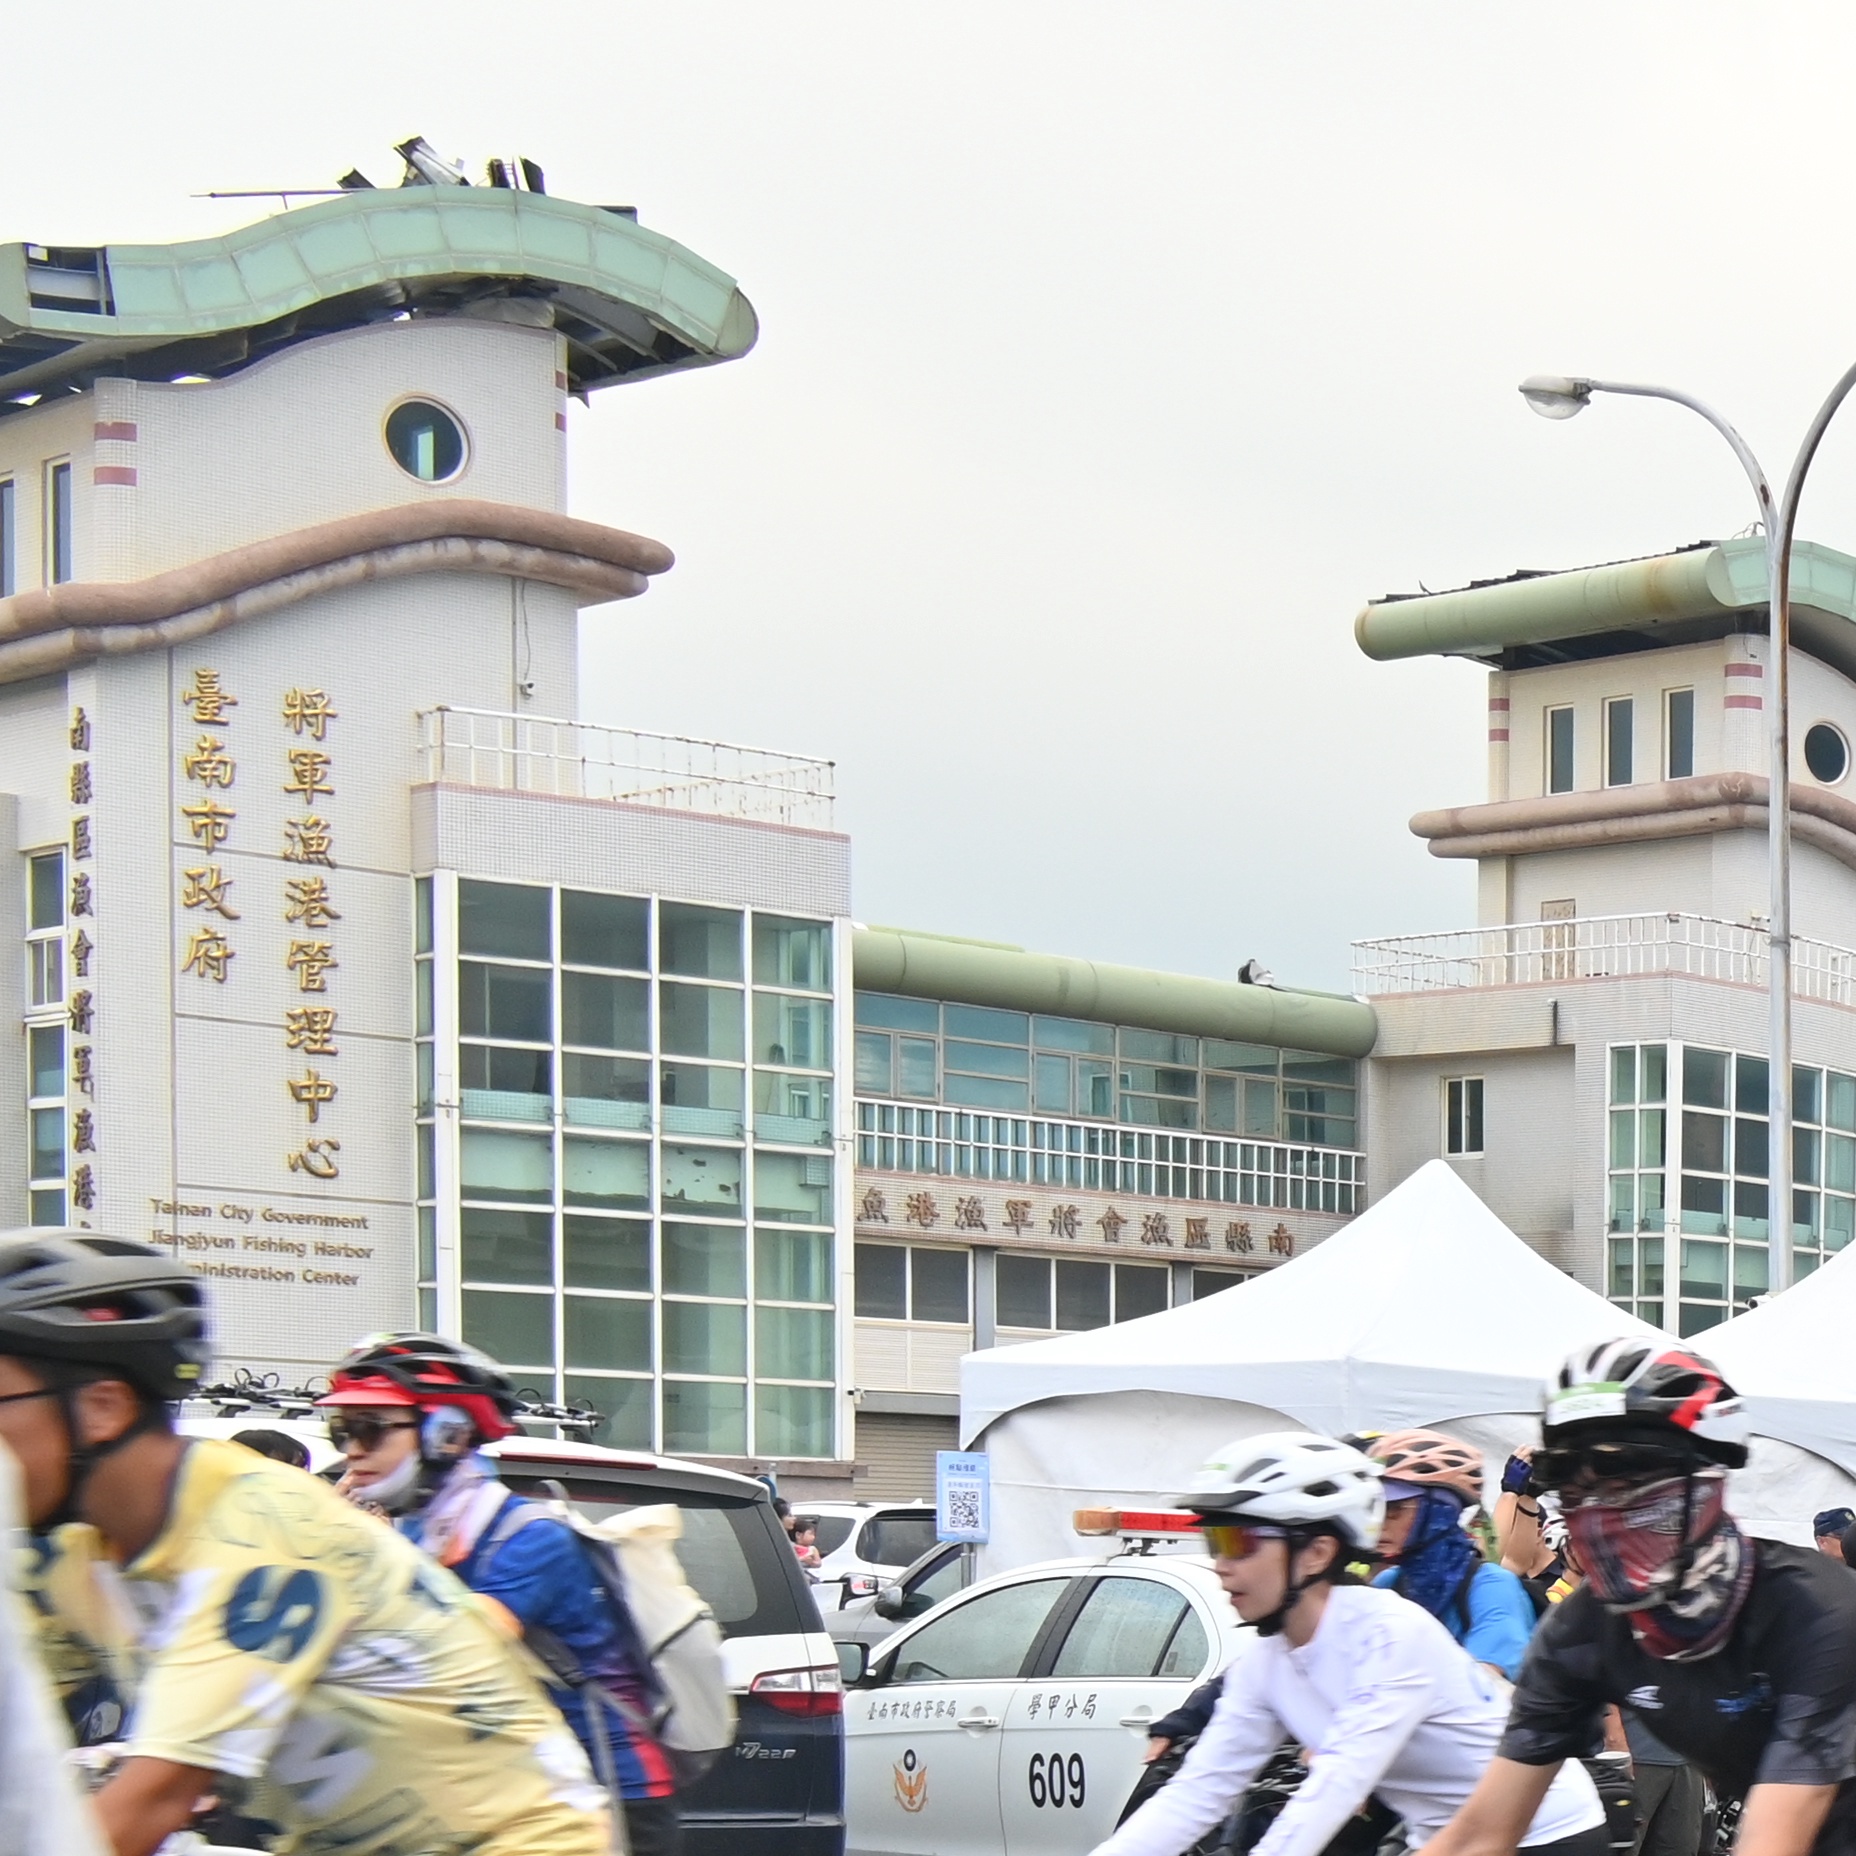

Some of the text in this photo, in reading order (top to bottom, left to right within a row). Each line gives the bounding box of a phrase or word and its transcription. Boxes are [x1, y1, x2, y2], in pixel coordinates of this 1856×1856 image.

[182, 668, 241, 984] 臺南市政府
[281, 687, 342, 1180] 將軍漁港管理中心
[69, 706, 97, 1229] 南縣區漁會將軍漁港
[150, 1198, 370, 1229] Tainan City Government
[242, 1235, 307, 1258] Fishing
[314, 1241, 375, 1259] Harbor
[302, 1268, 360, 1286] Center
[866, 1699, 957, 1721] 臺南市政府警察局
[1027, 1693, 1098, 1721] 學甲分局
[1028, 1752, 1086, 1809] 609
